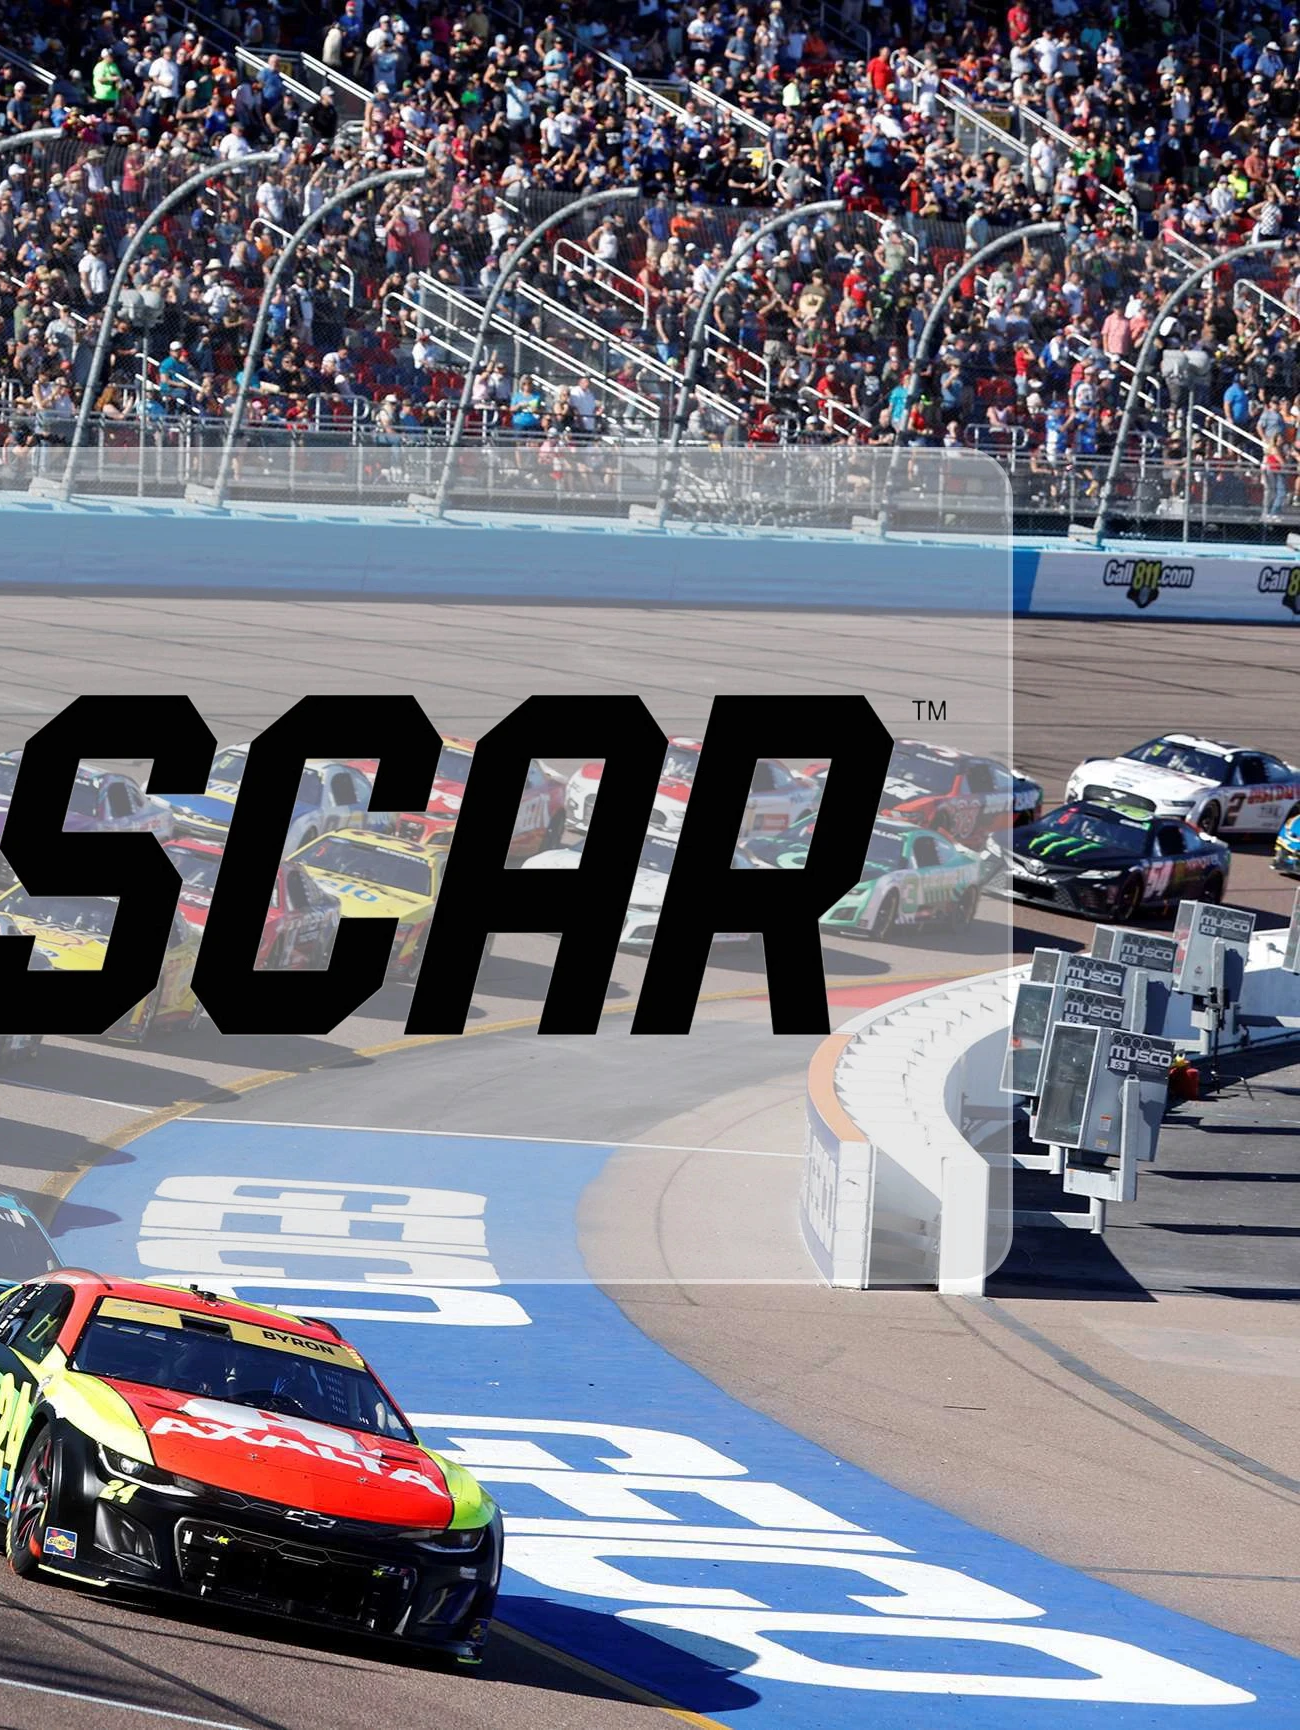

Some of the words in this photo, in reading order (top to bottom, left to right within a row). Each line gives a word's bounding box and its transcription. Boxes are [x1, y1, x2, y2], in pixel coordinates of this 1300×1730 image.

[1258, 566, 1300, 597] Call8
[1221, 792, 1246, 827] 2
[136, 1175, 533, 1327] GEICO
[263, 1329, 337, 1357] BYRON
[150, 1417, 453, 1498] AXALTA
[101, 1479, 141, 1504] 24
[408, 1412, 1257, 1707] GEICO
